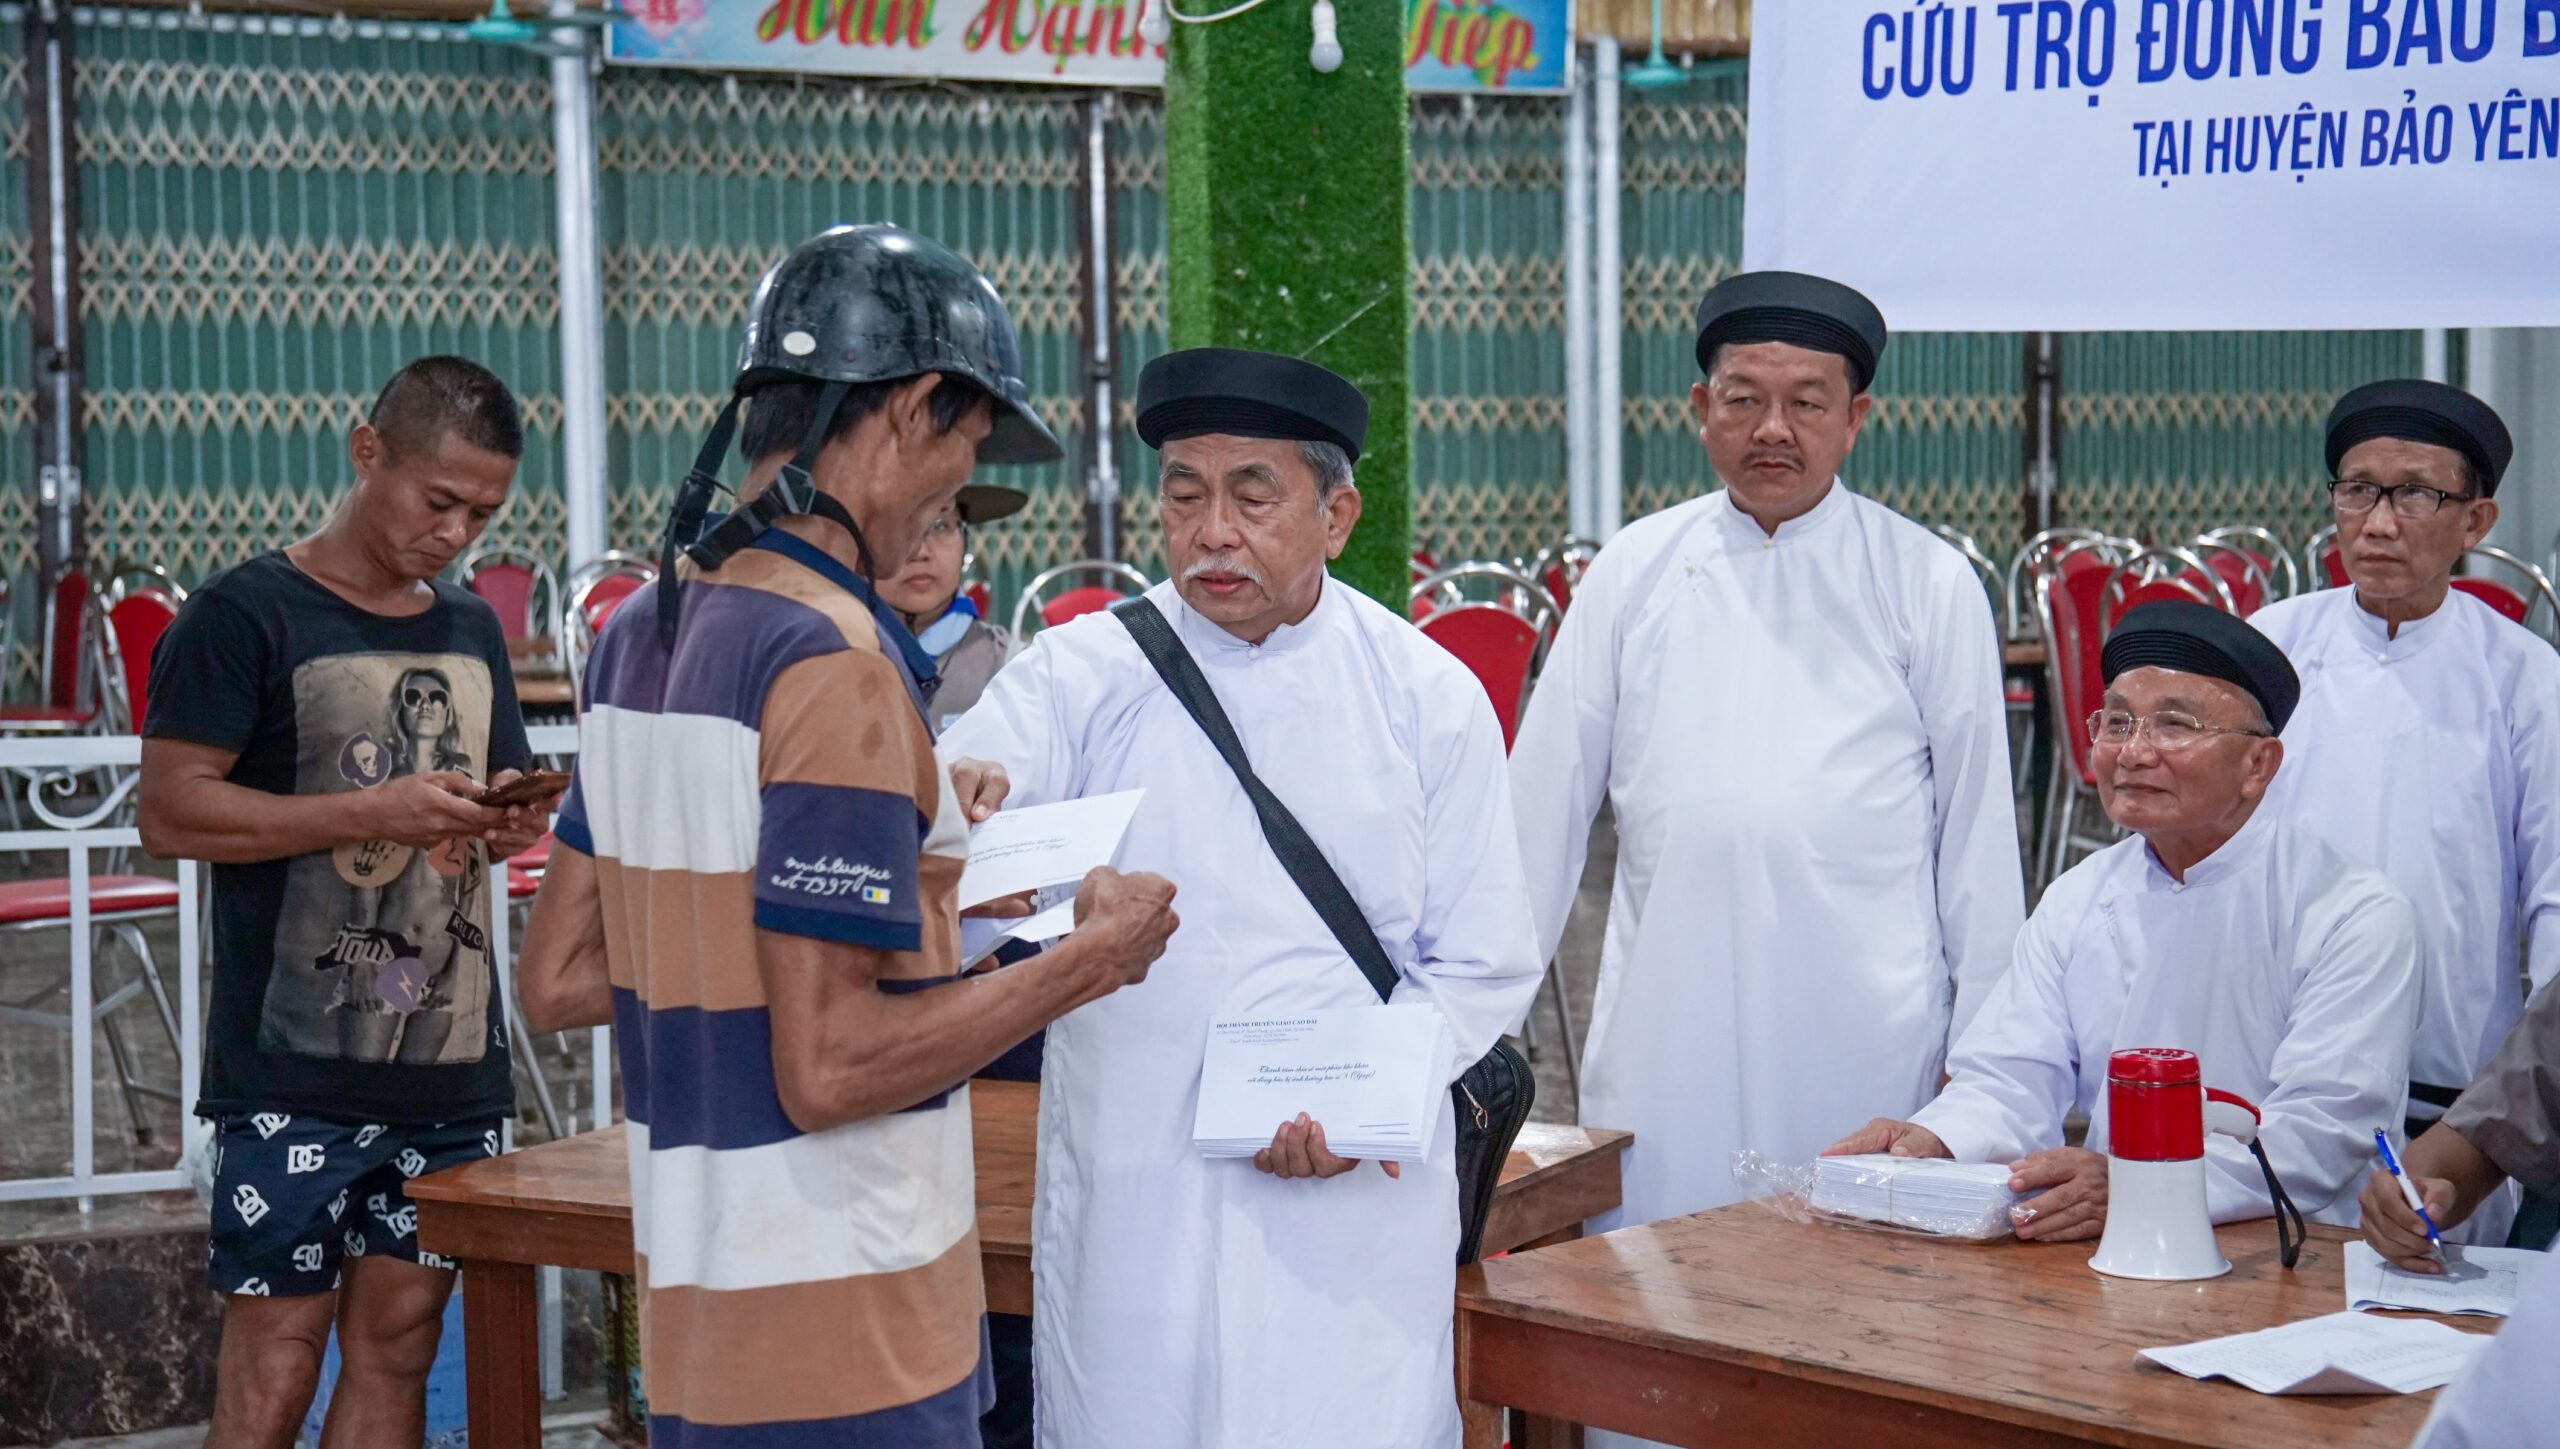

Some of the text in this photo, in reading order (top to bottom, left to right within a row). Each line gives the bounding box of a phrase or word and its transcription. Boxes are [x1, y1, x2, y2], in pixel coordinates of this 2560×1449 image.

[1862, 0, 1977, 100] CỨU
[2133, 88, 2560, 188] TẠI HUYỆN BẢO YÊN
[287, 1143, 325, 1174] DG
[293, 1243, 323, 1272] DG
